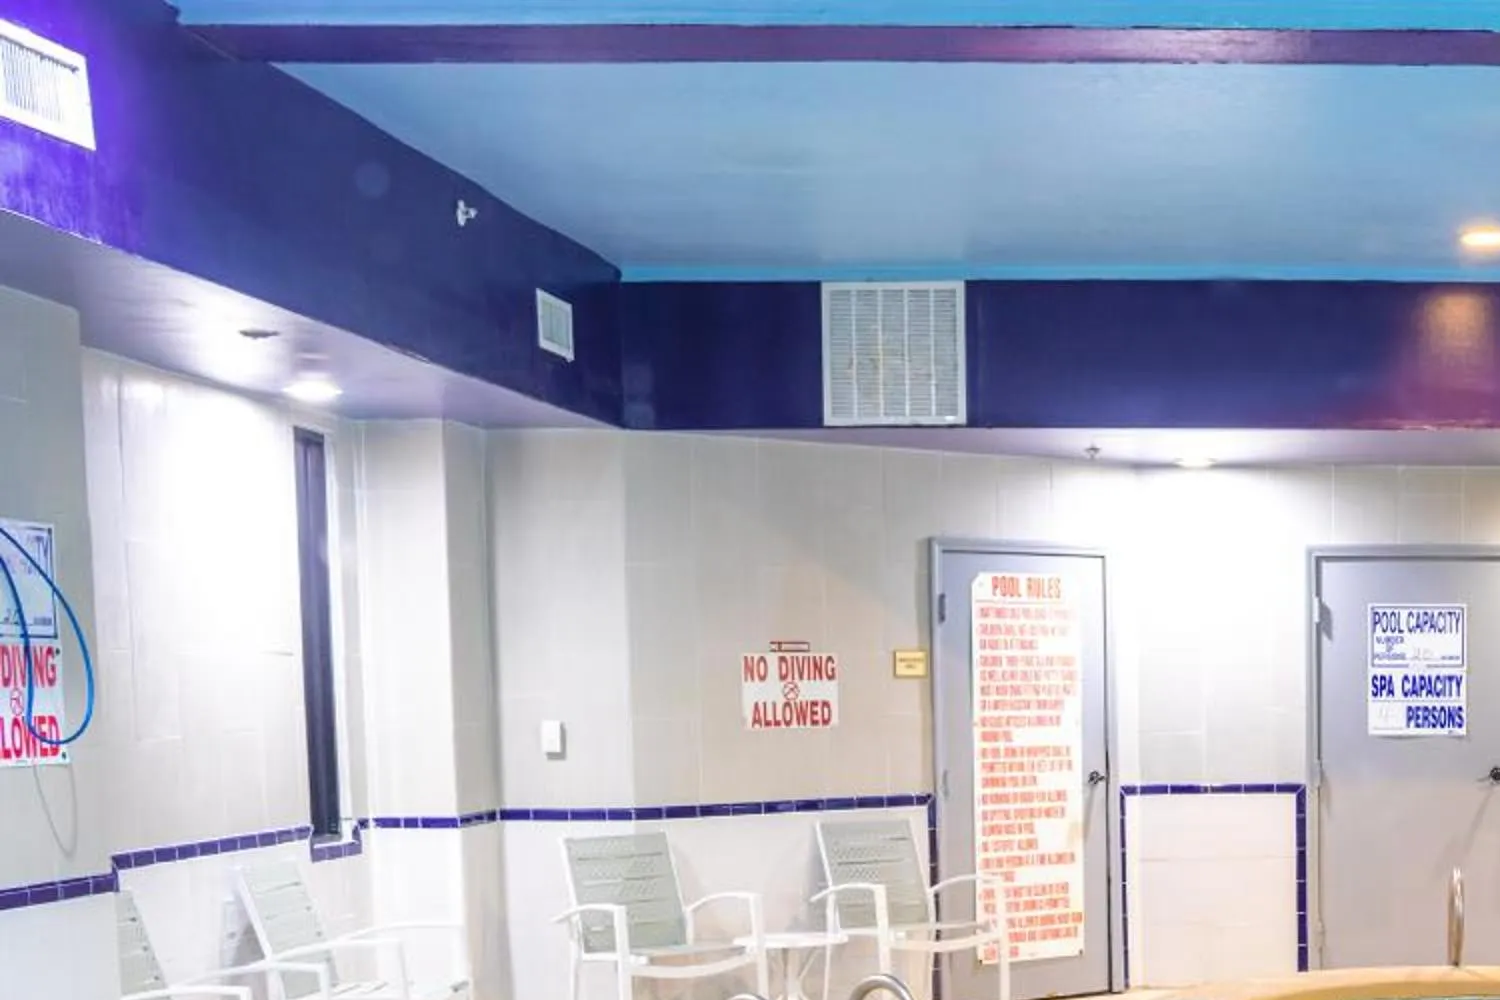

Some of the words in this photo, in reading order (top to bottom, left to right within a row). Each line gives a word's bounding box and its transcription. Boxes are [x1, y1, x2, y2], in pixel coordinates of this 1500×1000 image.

[991, 575, 1022, 597] POOL
[1026, 577, 1061, 599] RULES
[1373, 611, 1404, 634] POOL
[1406, 611, 1461, 634] CAPACITY
[0, 646, 57, 689] DIVNG
[743, 655, 768, 682] NO
[779, 655, 836, 681] DIVING
[1371, 674, 1395, 698] SPA
[1402, 674, 1463, 698] CAPACITY
[750, 701, 832, 729] ALLOWED
[1406, 706, 1464, 729] PERSONS
[0, 715, 60, 760] LOWED
